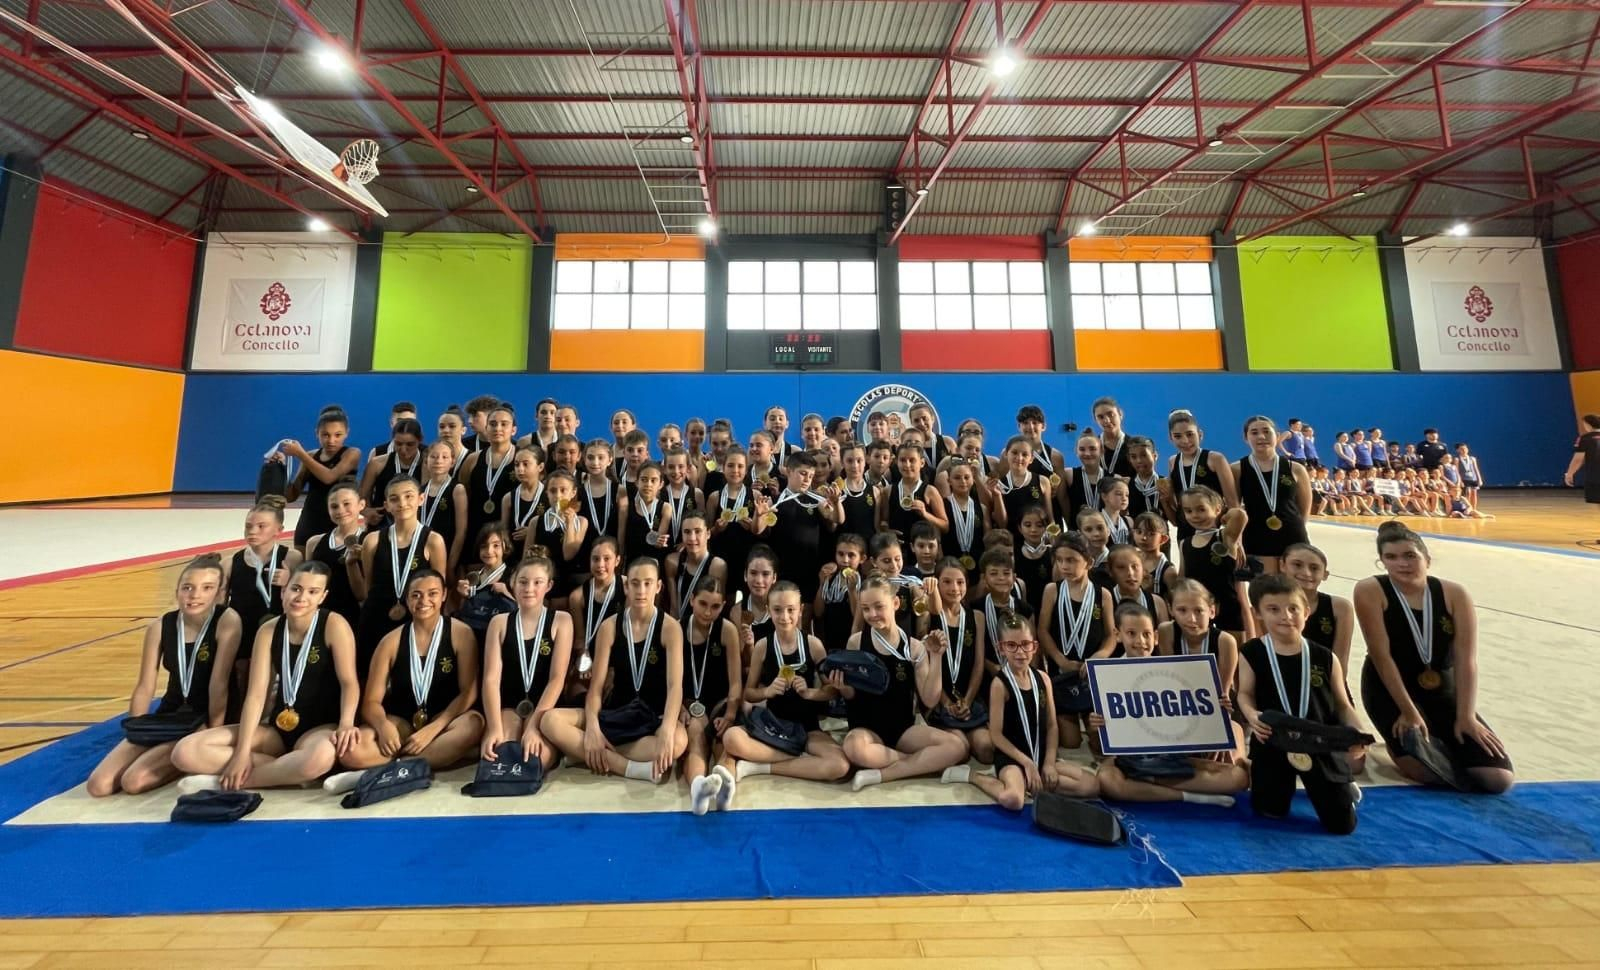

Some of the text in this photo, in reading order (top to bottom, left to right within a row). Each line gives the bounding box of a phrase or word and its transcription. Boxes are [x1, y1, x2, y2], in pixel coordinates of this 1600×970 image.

[242, 339, 300, 351] Concello
[1457, 341, 1511, 352] Concello
[851, 389, 882, 422] ESCOLAS
[1106, 688, 1215, 719] BURGAS
